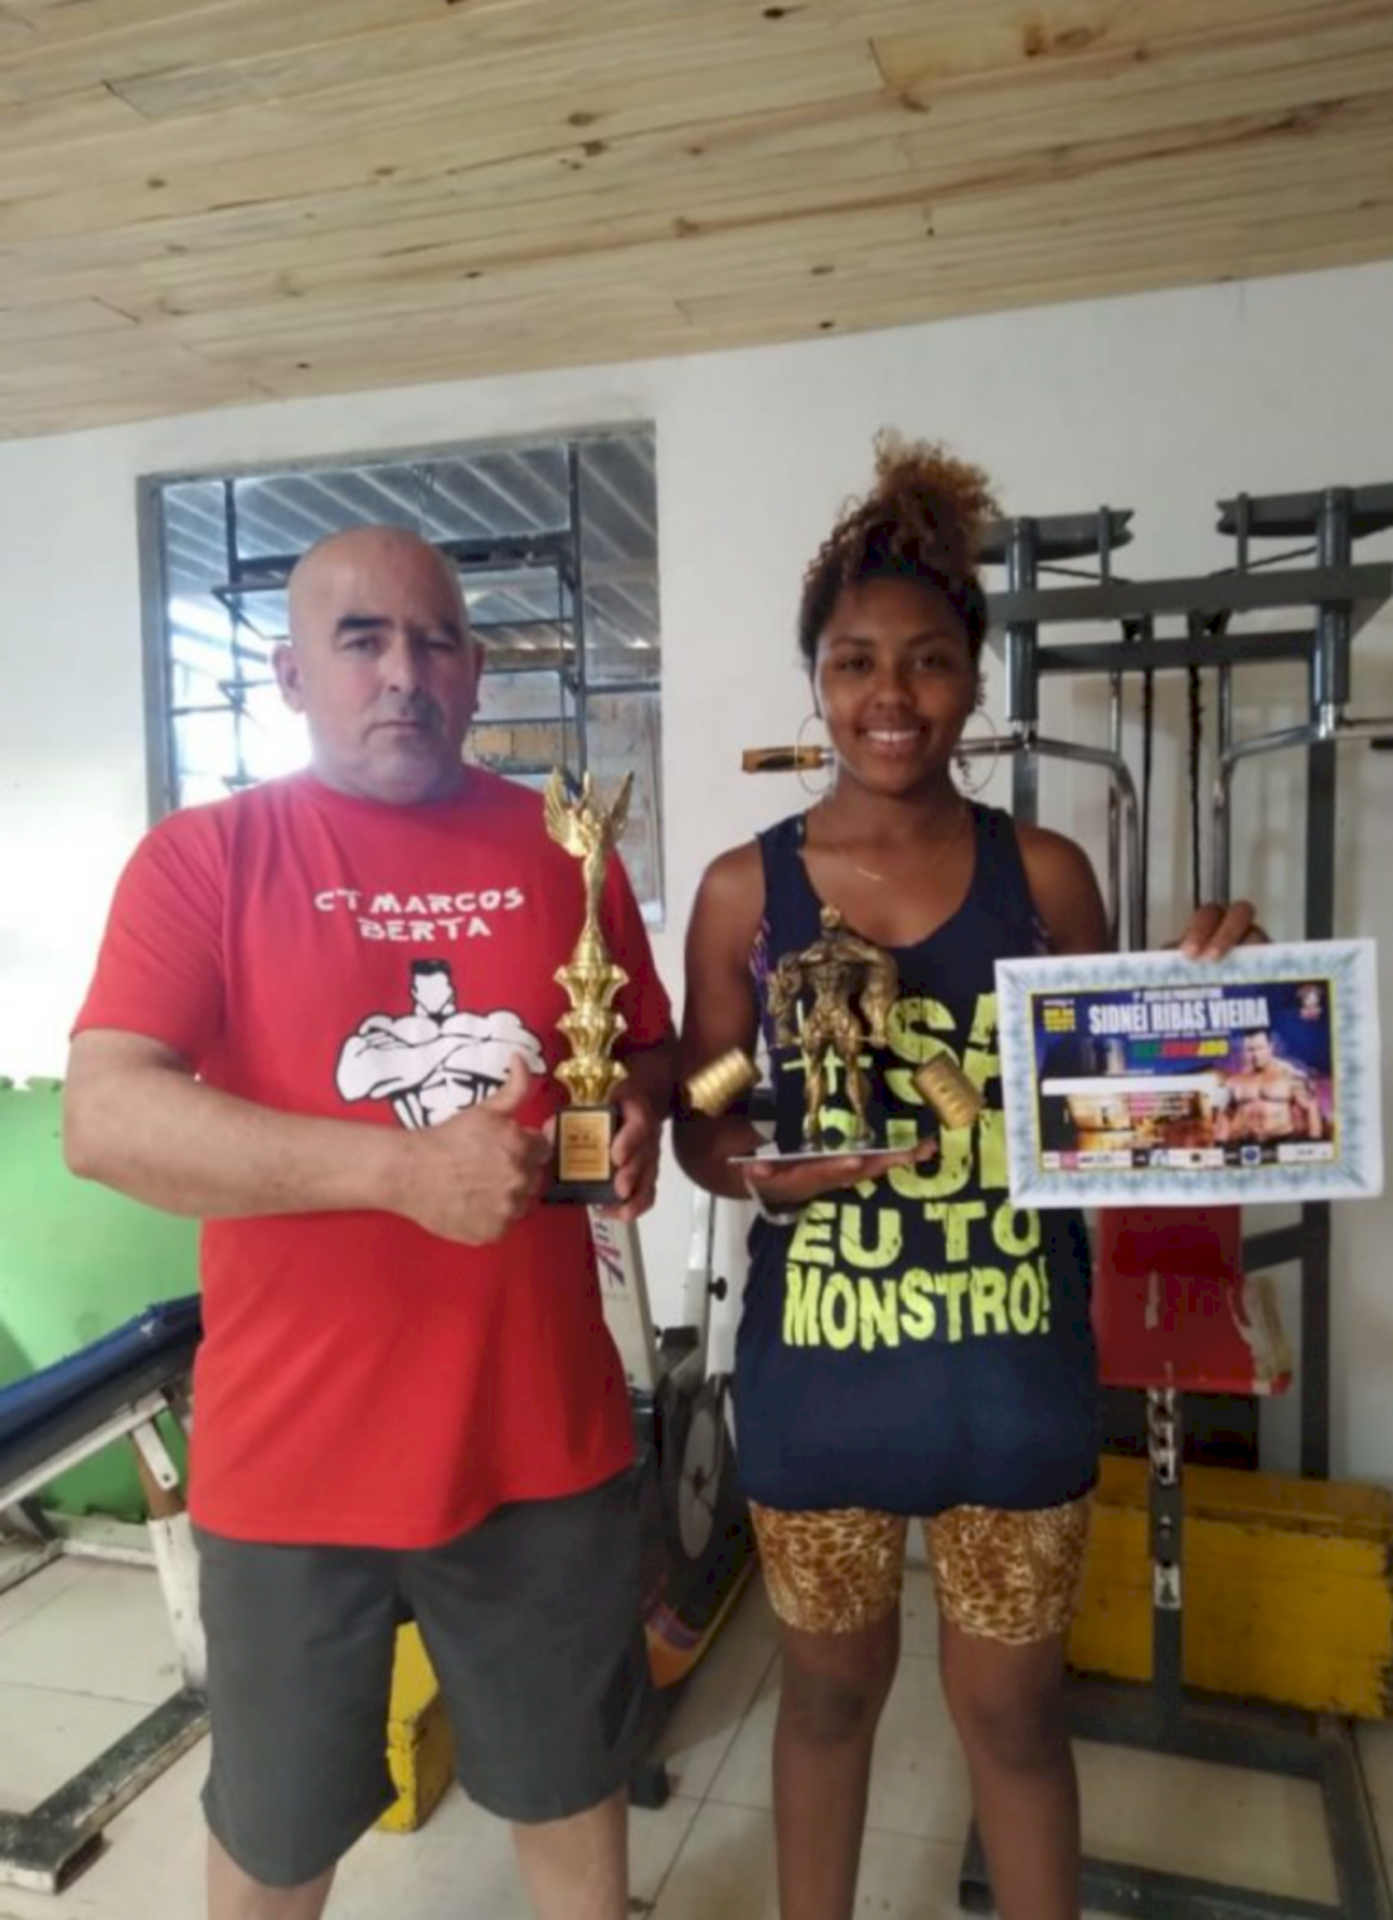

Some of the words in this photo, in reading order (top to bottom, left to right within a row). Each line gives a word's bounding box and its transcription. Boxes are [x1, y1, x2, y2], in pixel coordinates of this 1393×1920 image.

[314, 888, 361, 911] CT
[369, 887, 525, 914] MARCOS
[357, 917, 492, 942] BERTA
[1088, 1003, 1148, 1035] SIDNEI
[1208, 997, 1270, 1029] VIEIRA
[787, 1201, 903, 1269] EU
[782, 1256, 1052, 1353] MONSTRO!
